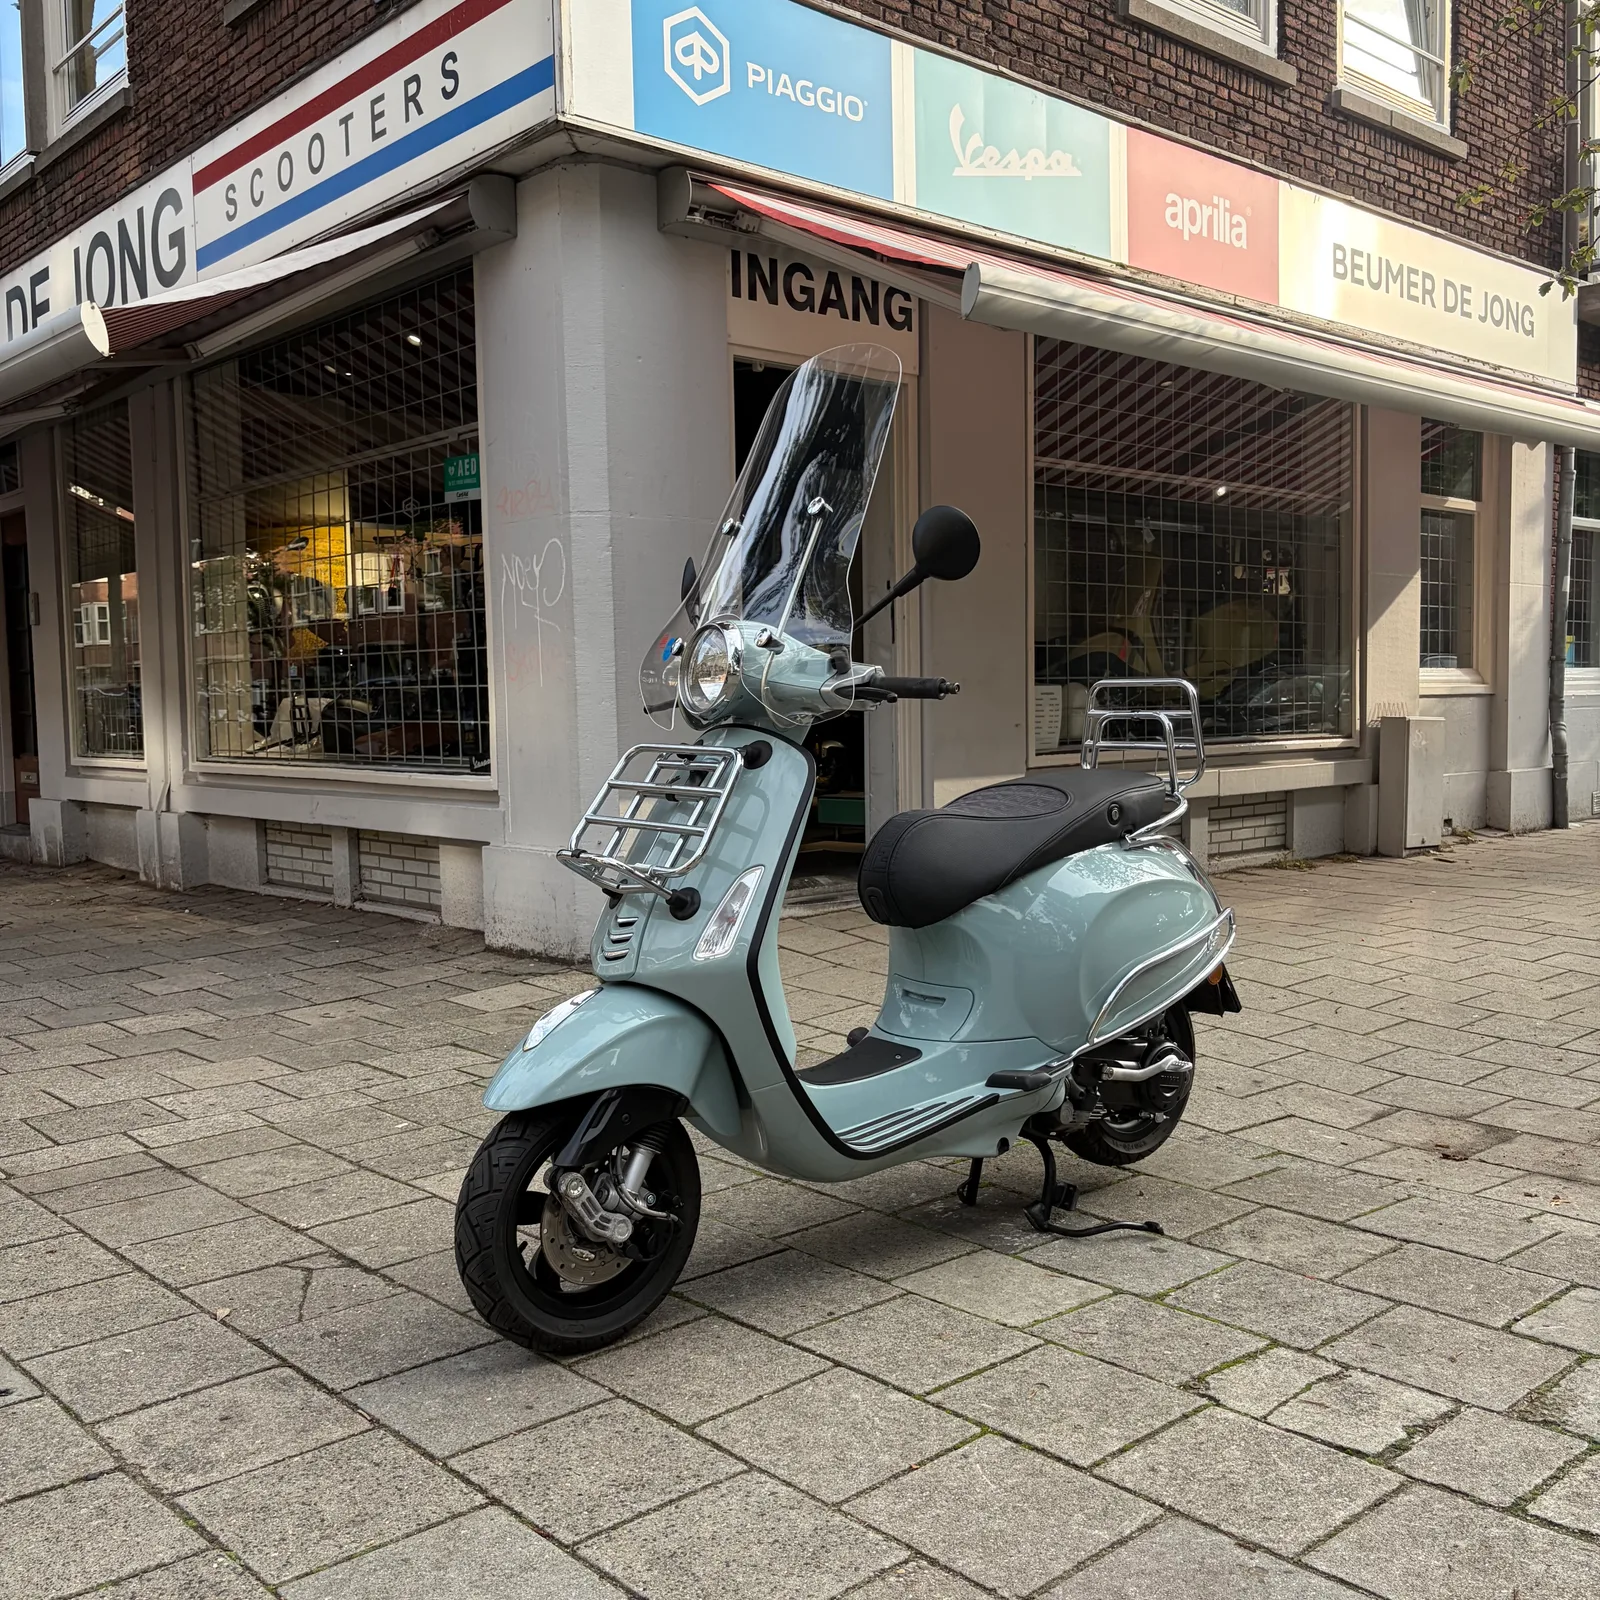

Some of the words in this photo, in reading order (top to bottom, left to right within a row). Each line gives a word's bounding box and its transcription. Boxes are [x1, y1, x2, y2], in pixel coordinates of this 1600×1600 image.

[746, 62, 864, 122] PIAGGIO
[225, 51, 459, 222] SCOOTERS
[948, 103, 1083, 180] Vespa
[1164, 192, 1248, 250] aprilia
[731, 249, 914, 333] INGANG
[1332, 242, 1437, 308] BEUMER
[1443, 279, 1473, 319] DE
[1478, 289, 1536, 338] JONG
[457, 457, 477, 477] AED
